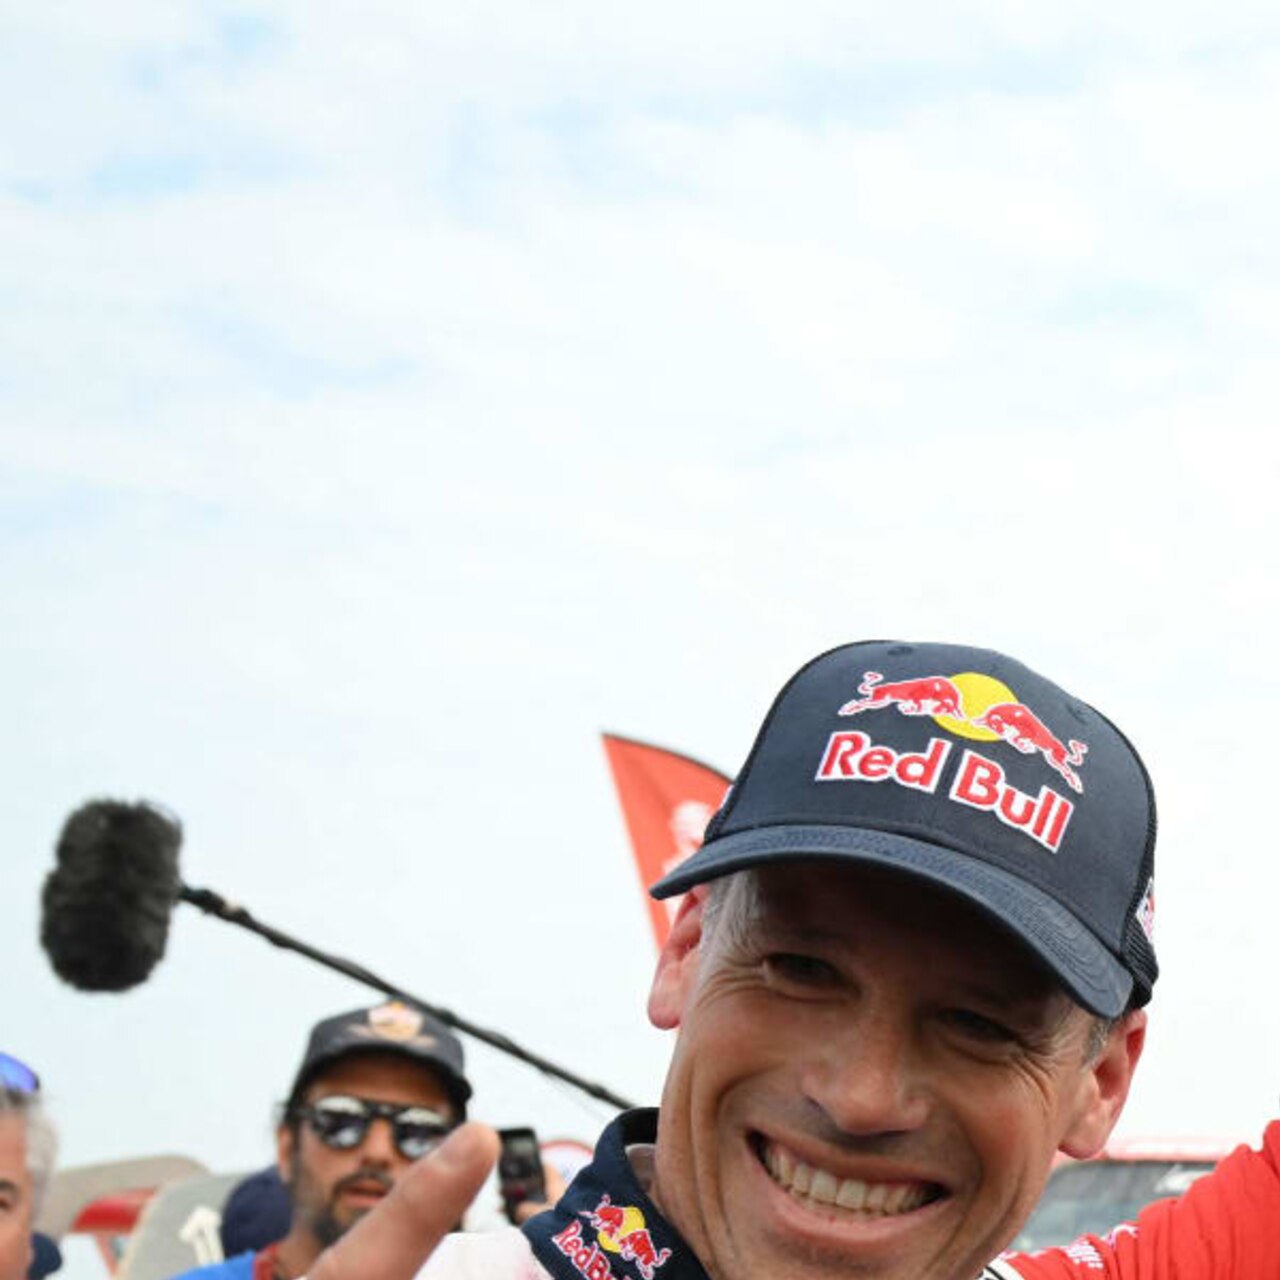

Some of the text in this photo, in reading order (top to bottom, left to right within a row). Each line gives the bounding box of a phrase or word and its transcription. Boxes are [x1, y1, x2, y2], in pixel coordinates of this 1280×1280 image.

[815, 731, 1074, 853] Red Bull
[552, 1219, 598, 1272] Red
